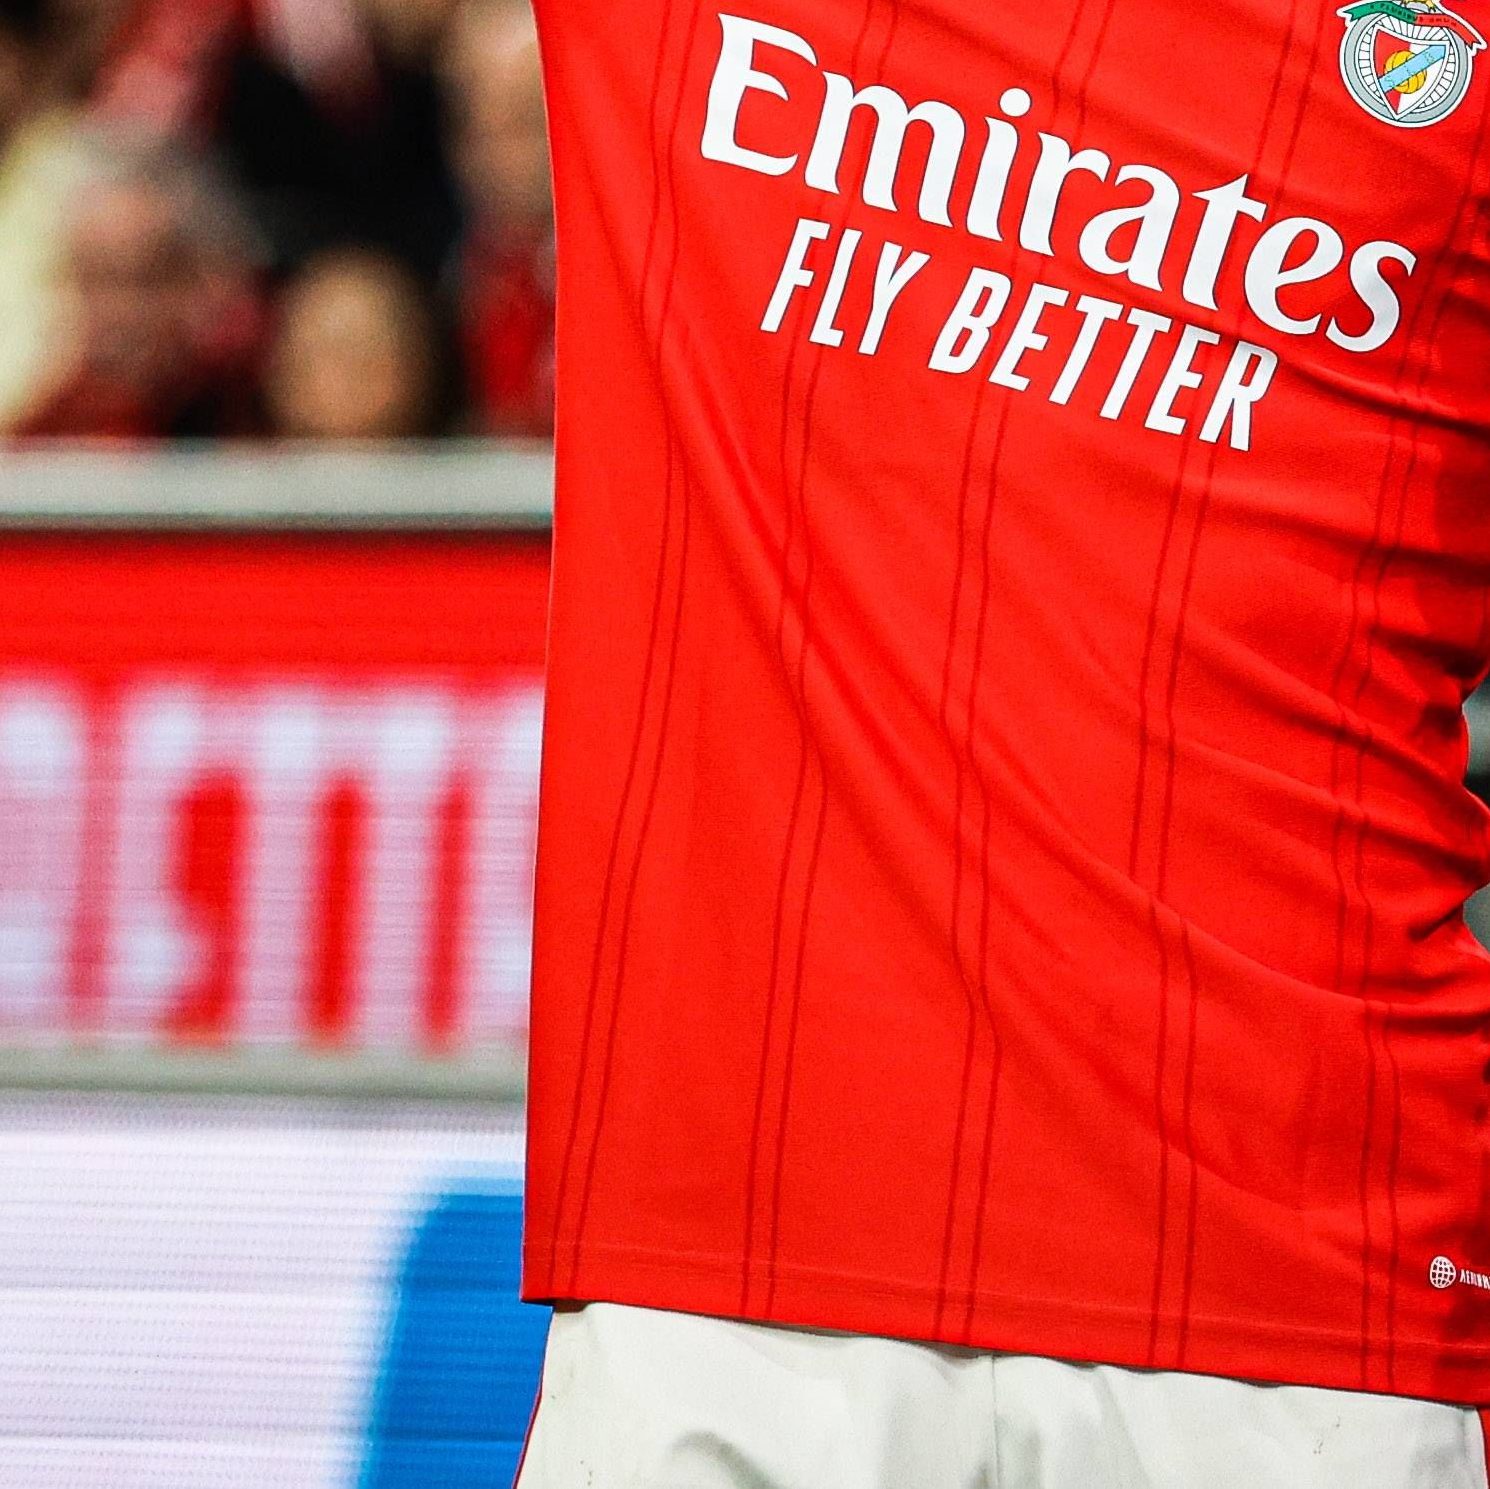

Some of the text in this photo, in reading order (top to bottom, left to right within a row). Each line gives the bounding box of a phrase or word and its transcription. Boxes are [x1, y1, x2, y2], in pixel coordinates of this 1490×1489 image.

[698, 12, 1418, 354] Emirates
[761, 219, 1279, 452] FLY BETTER
